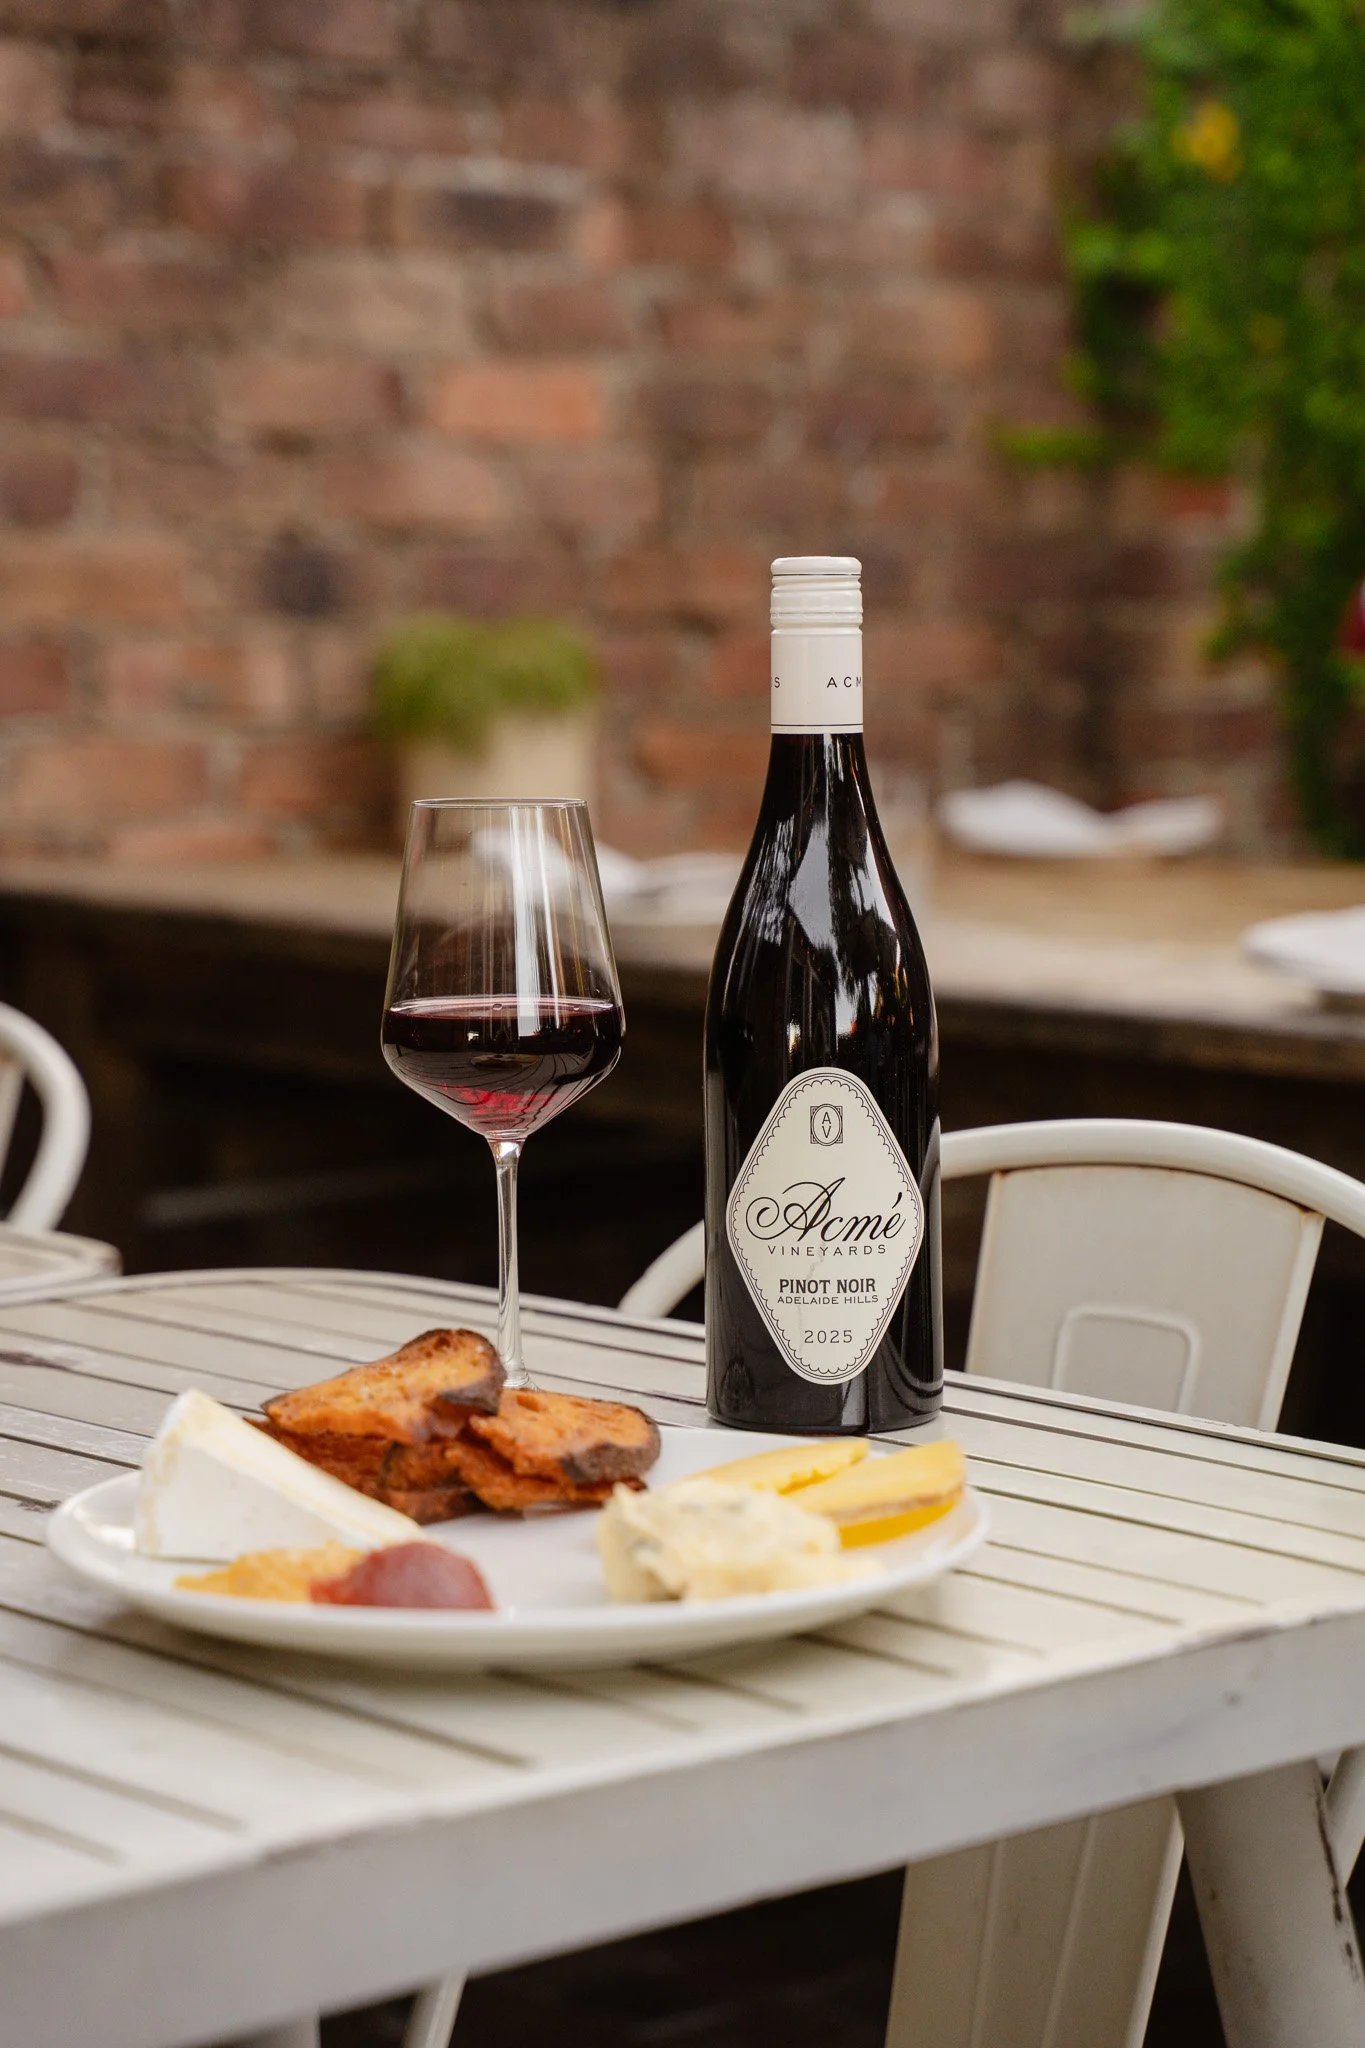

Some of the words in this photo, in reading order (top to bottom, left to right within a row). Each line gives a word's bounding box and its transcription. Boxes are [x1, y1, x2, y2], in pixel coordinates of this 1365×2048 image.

[745, 1177, 906, 1242] Acmé
[767, 1244, 886, 1257] VINEYARDS
[779, 1279, 830, 1294] PINOT
[836, 1278, 876, 1293] NOIR
[777, 1295, 839, 1305] ADELAIDE
[844, 1294, 879, 1304] HILLS
[804, 1330, 853, 1344] 2025
